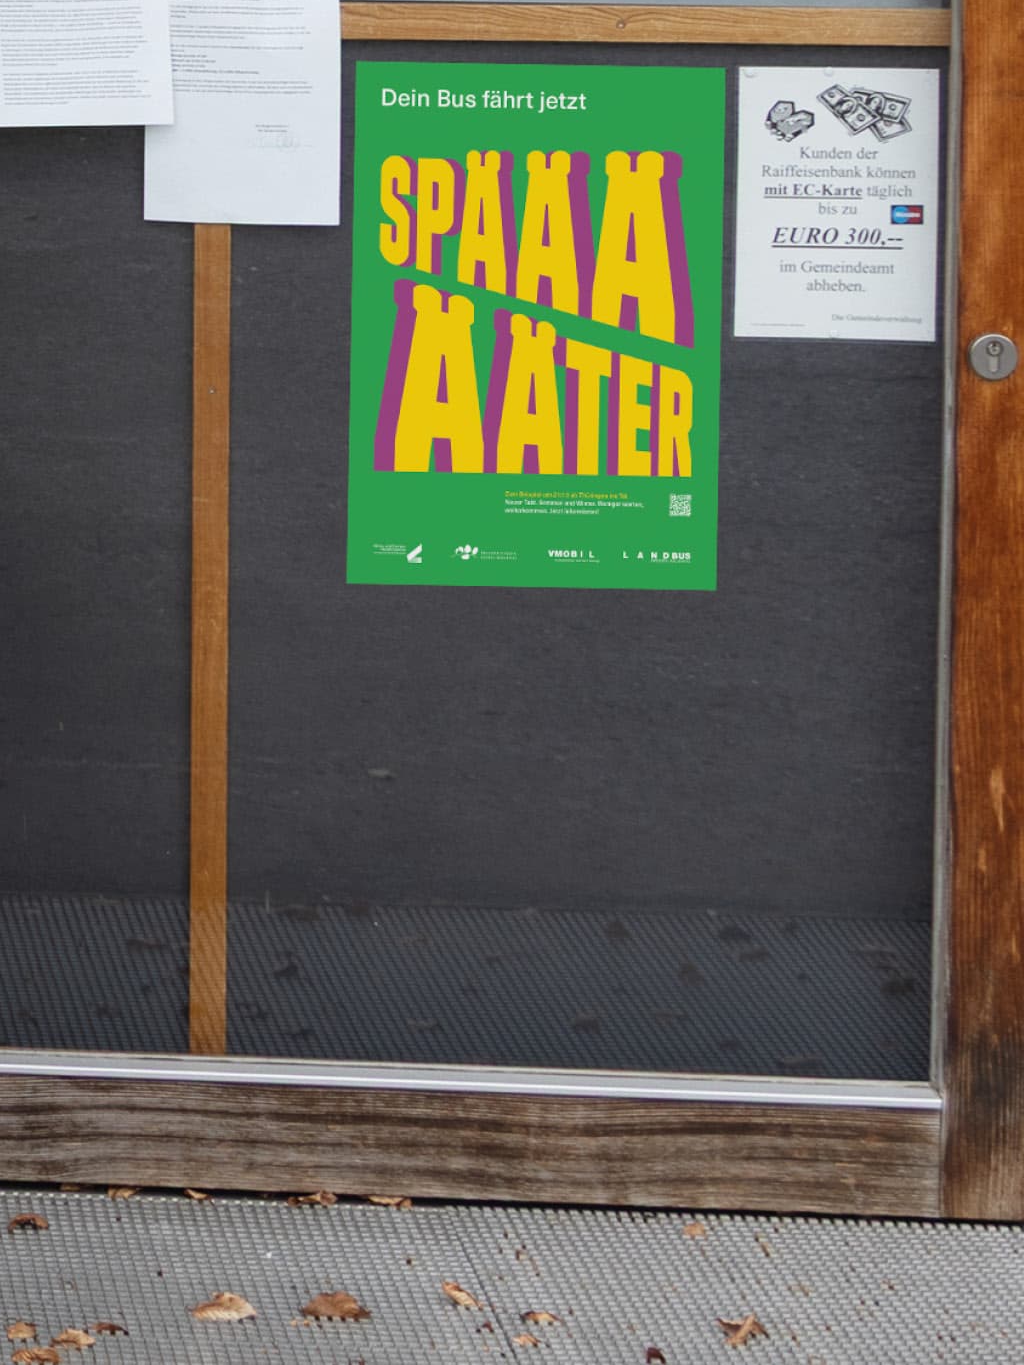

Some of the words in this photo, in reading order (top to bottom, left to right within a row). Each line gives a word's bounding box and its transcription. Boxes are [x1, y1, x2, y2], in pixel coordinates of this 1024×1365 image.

[381, 87, 430, 108] Dein
[437, 90, 476, 109] Bus
[482, 90, 534, 110] fährt
[538, 92, 587, 114] jetzt
[800, 146, 852, 160] Kunden
[856, 147, 878, 160] der
[762, 165, 863, 179] Raiffeisenbank
[866, 166, 916, 179] können
[764, 184, 787, 196] mit
[792, 184, 862, 196] EC-Karte
[866, 185, 913, 200] täglich
[818, 202, 838, 215] bis
[842, 206, 857, 215] zu
[772, 226, 839, 245] EURO
[379, 150, 688, 346] SPÄÄÄ
[780, 260, 796, 273] im
[801, 260, 894, 275] Gemeindeamt
[806, 279, 866, 293] abheben.
[376, 280, 693, 477] ÄÄTER
